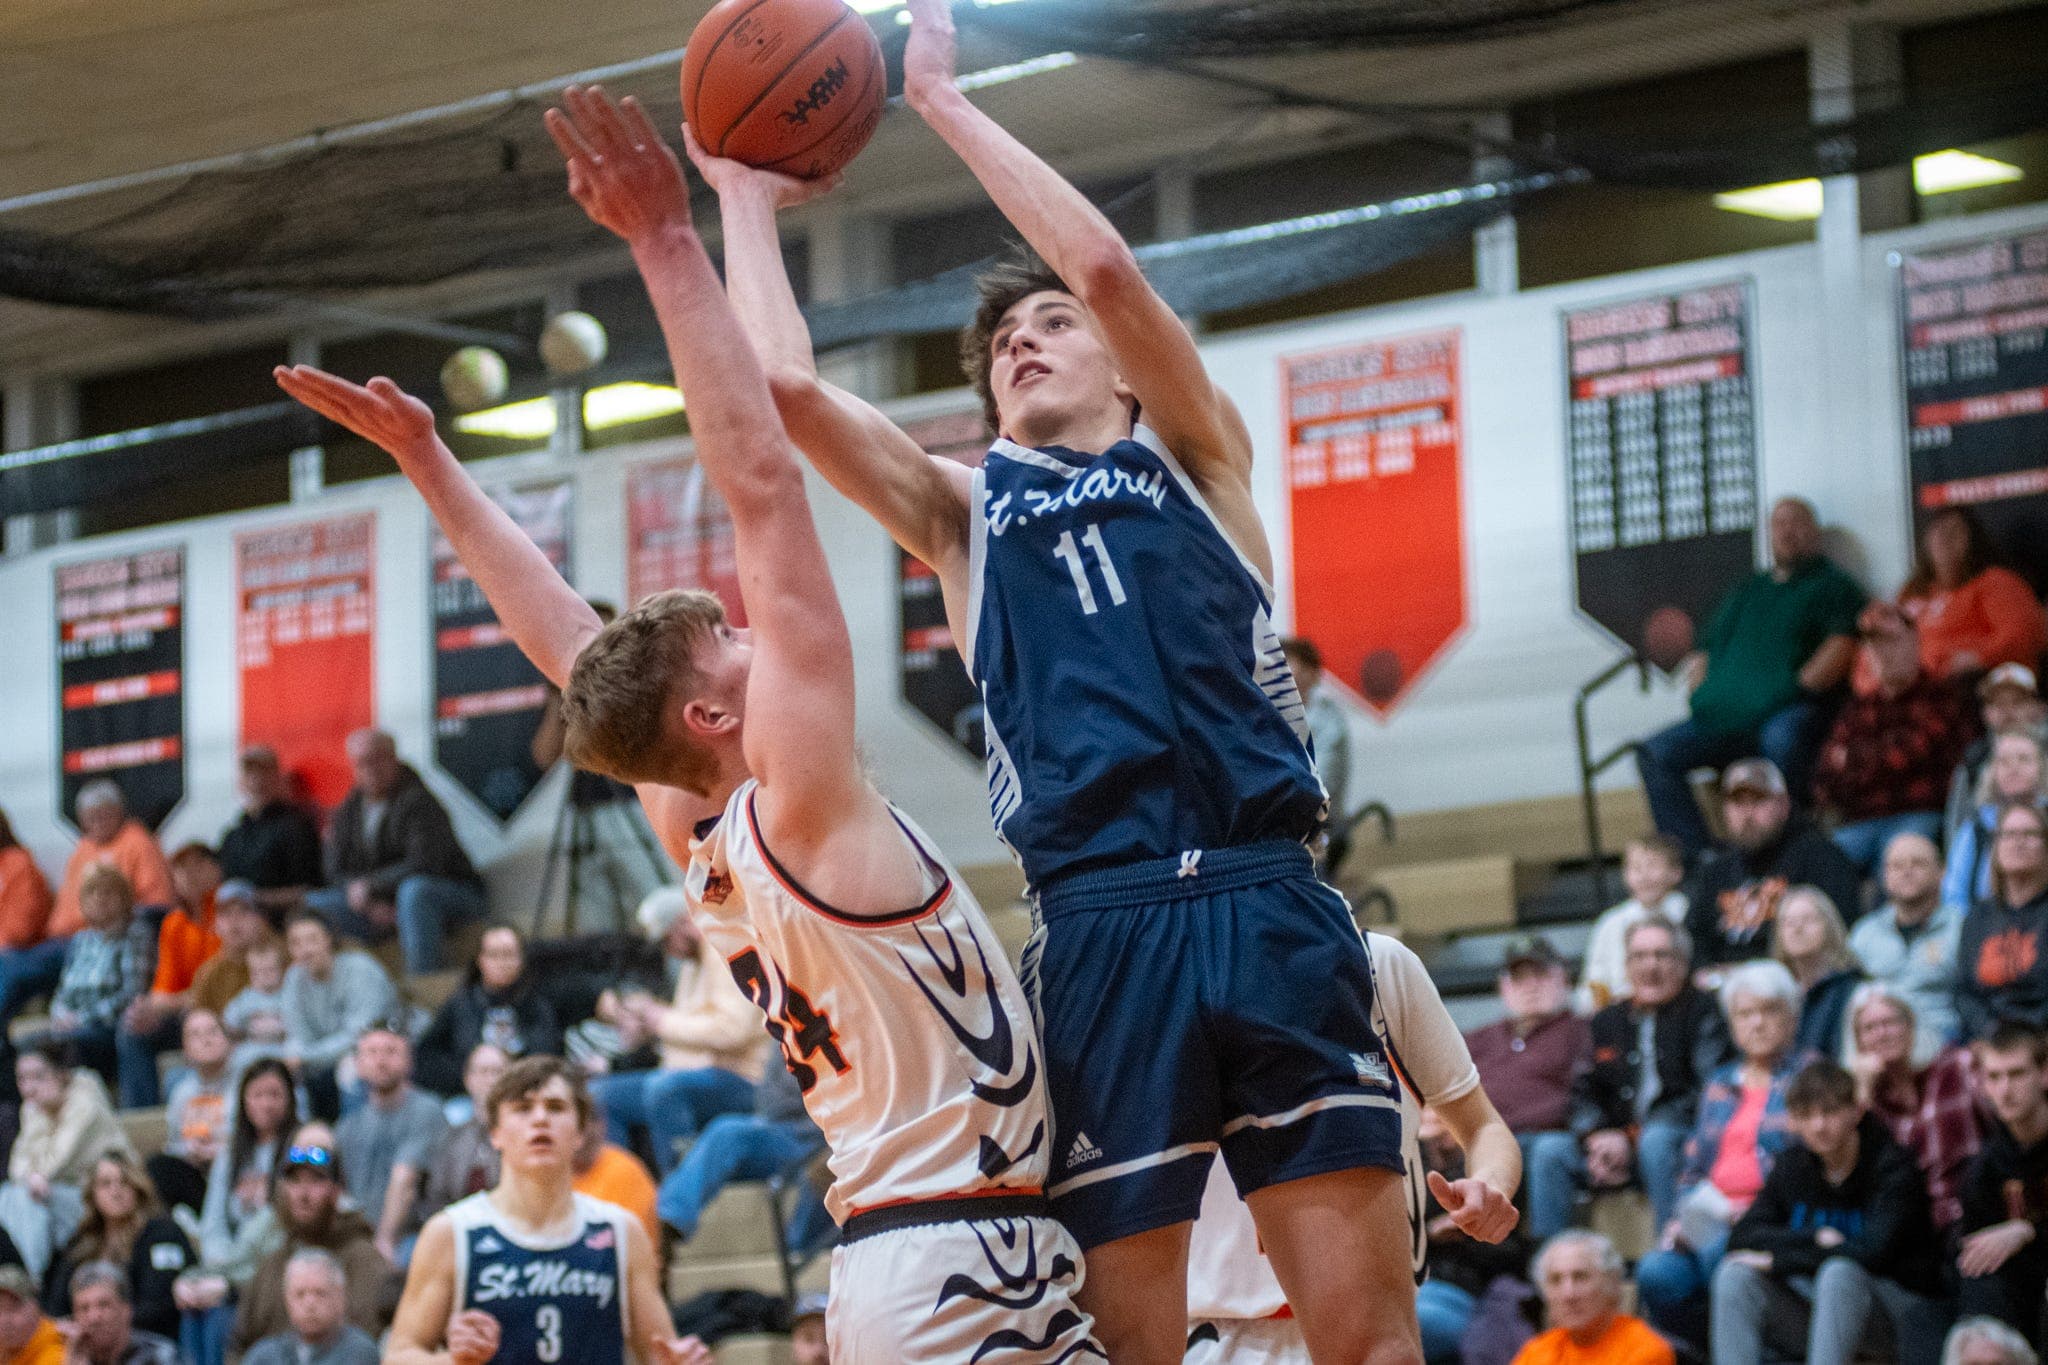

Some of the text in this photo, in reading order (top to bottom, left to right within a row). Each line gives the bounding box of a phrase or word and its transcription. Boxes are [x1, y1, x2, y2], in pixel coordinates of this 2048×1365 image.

[1053, 523, 1128, 615] 11
[1066, 1147, 1103, 1168] adidas
[535, 1302, 562, 1363] 3
